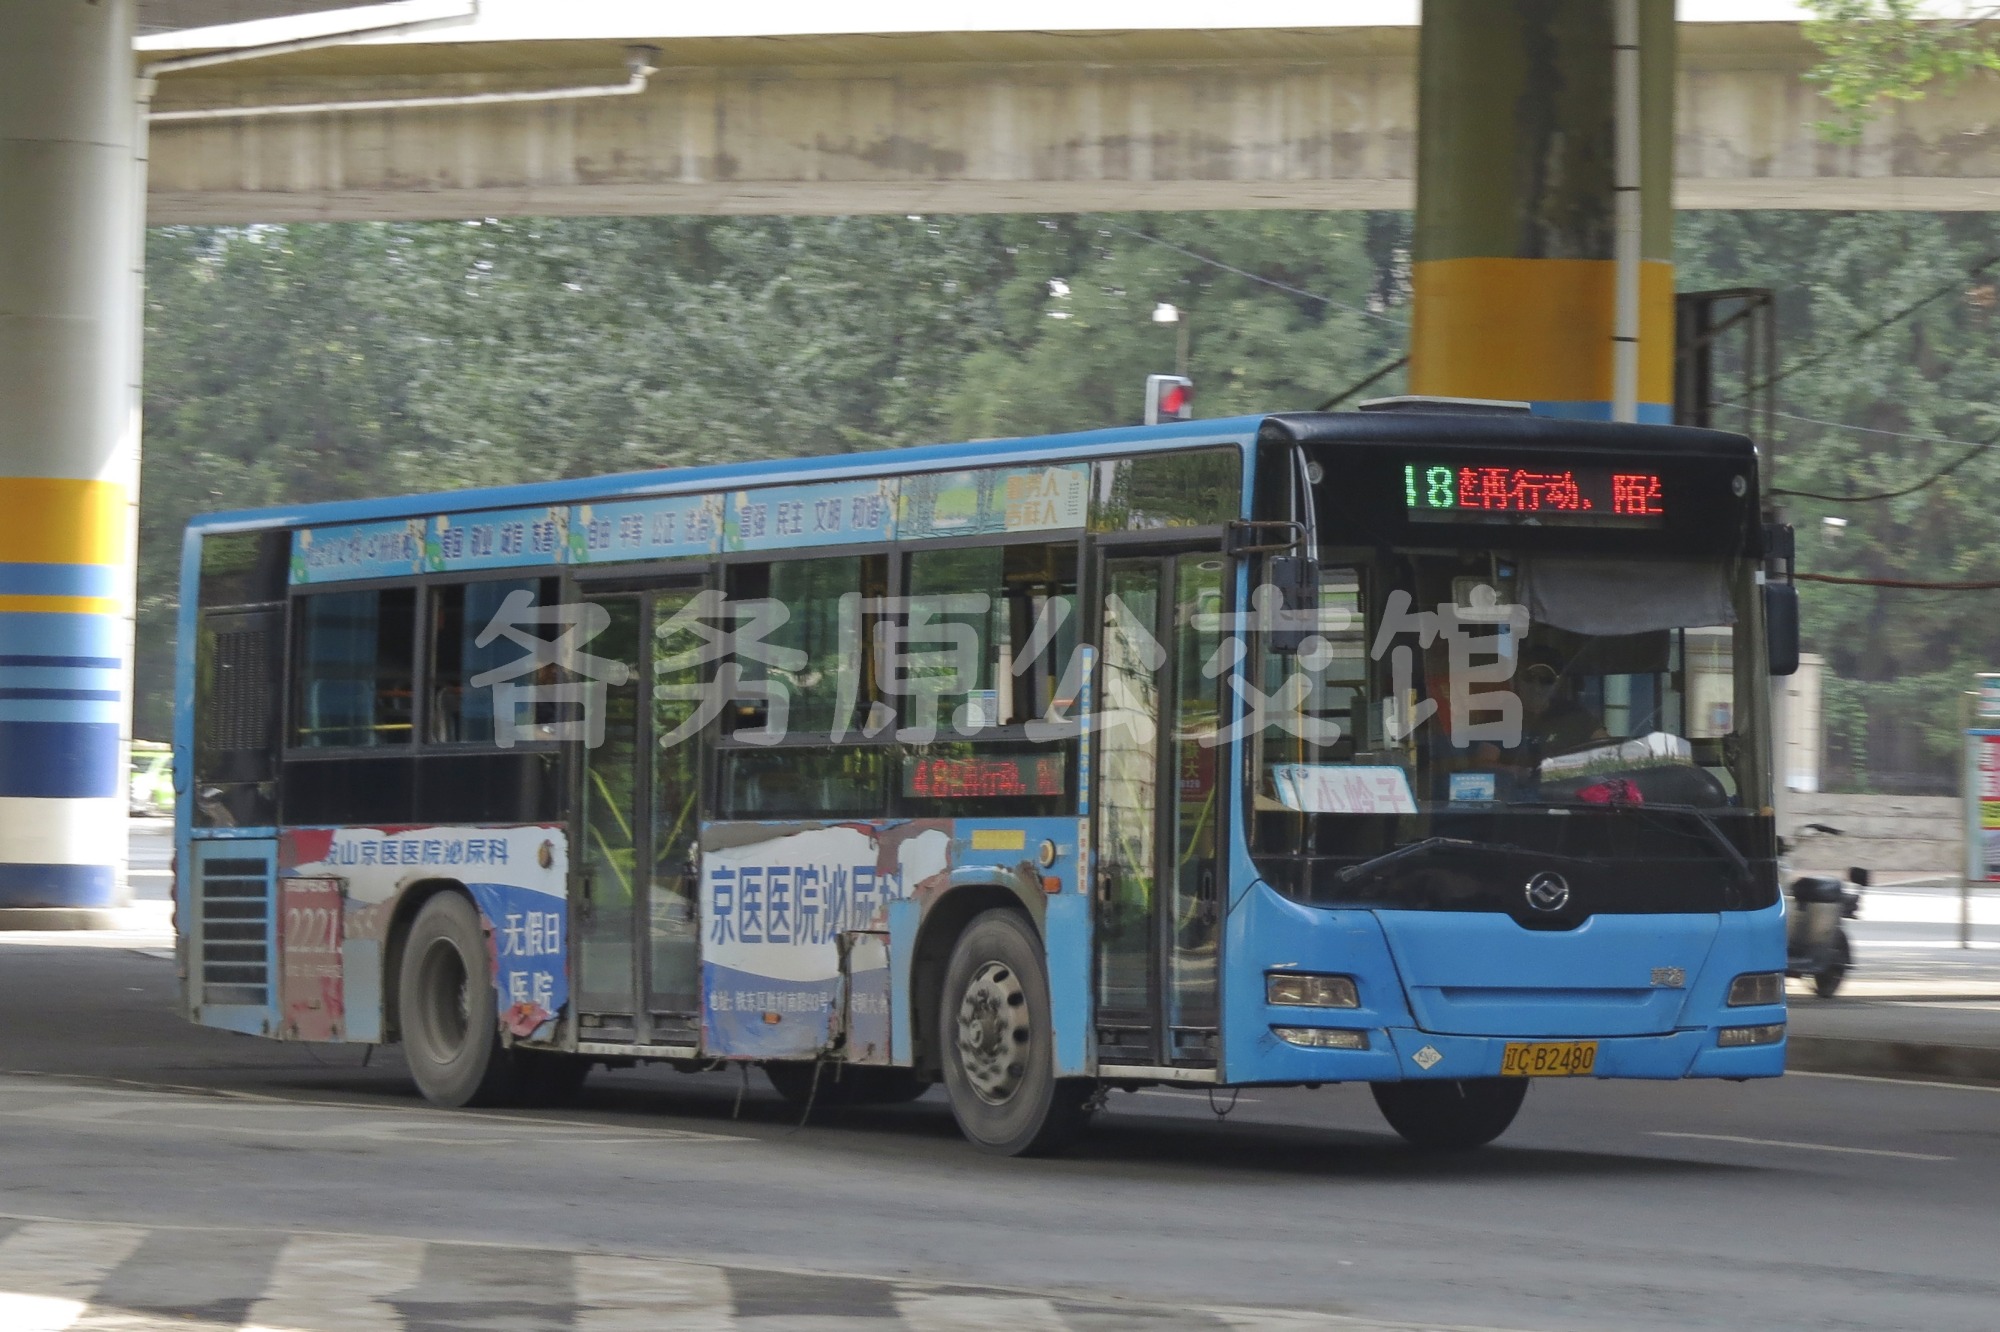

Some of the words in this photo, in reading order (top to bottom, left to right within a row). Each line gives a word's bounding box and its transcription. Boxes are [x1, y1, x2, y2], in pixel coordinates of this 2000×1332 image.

[776, 501, 803, 534] 民主
[813, 498, 842, 531] 文明
[503, 910, 560, 956] 无假日
